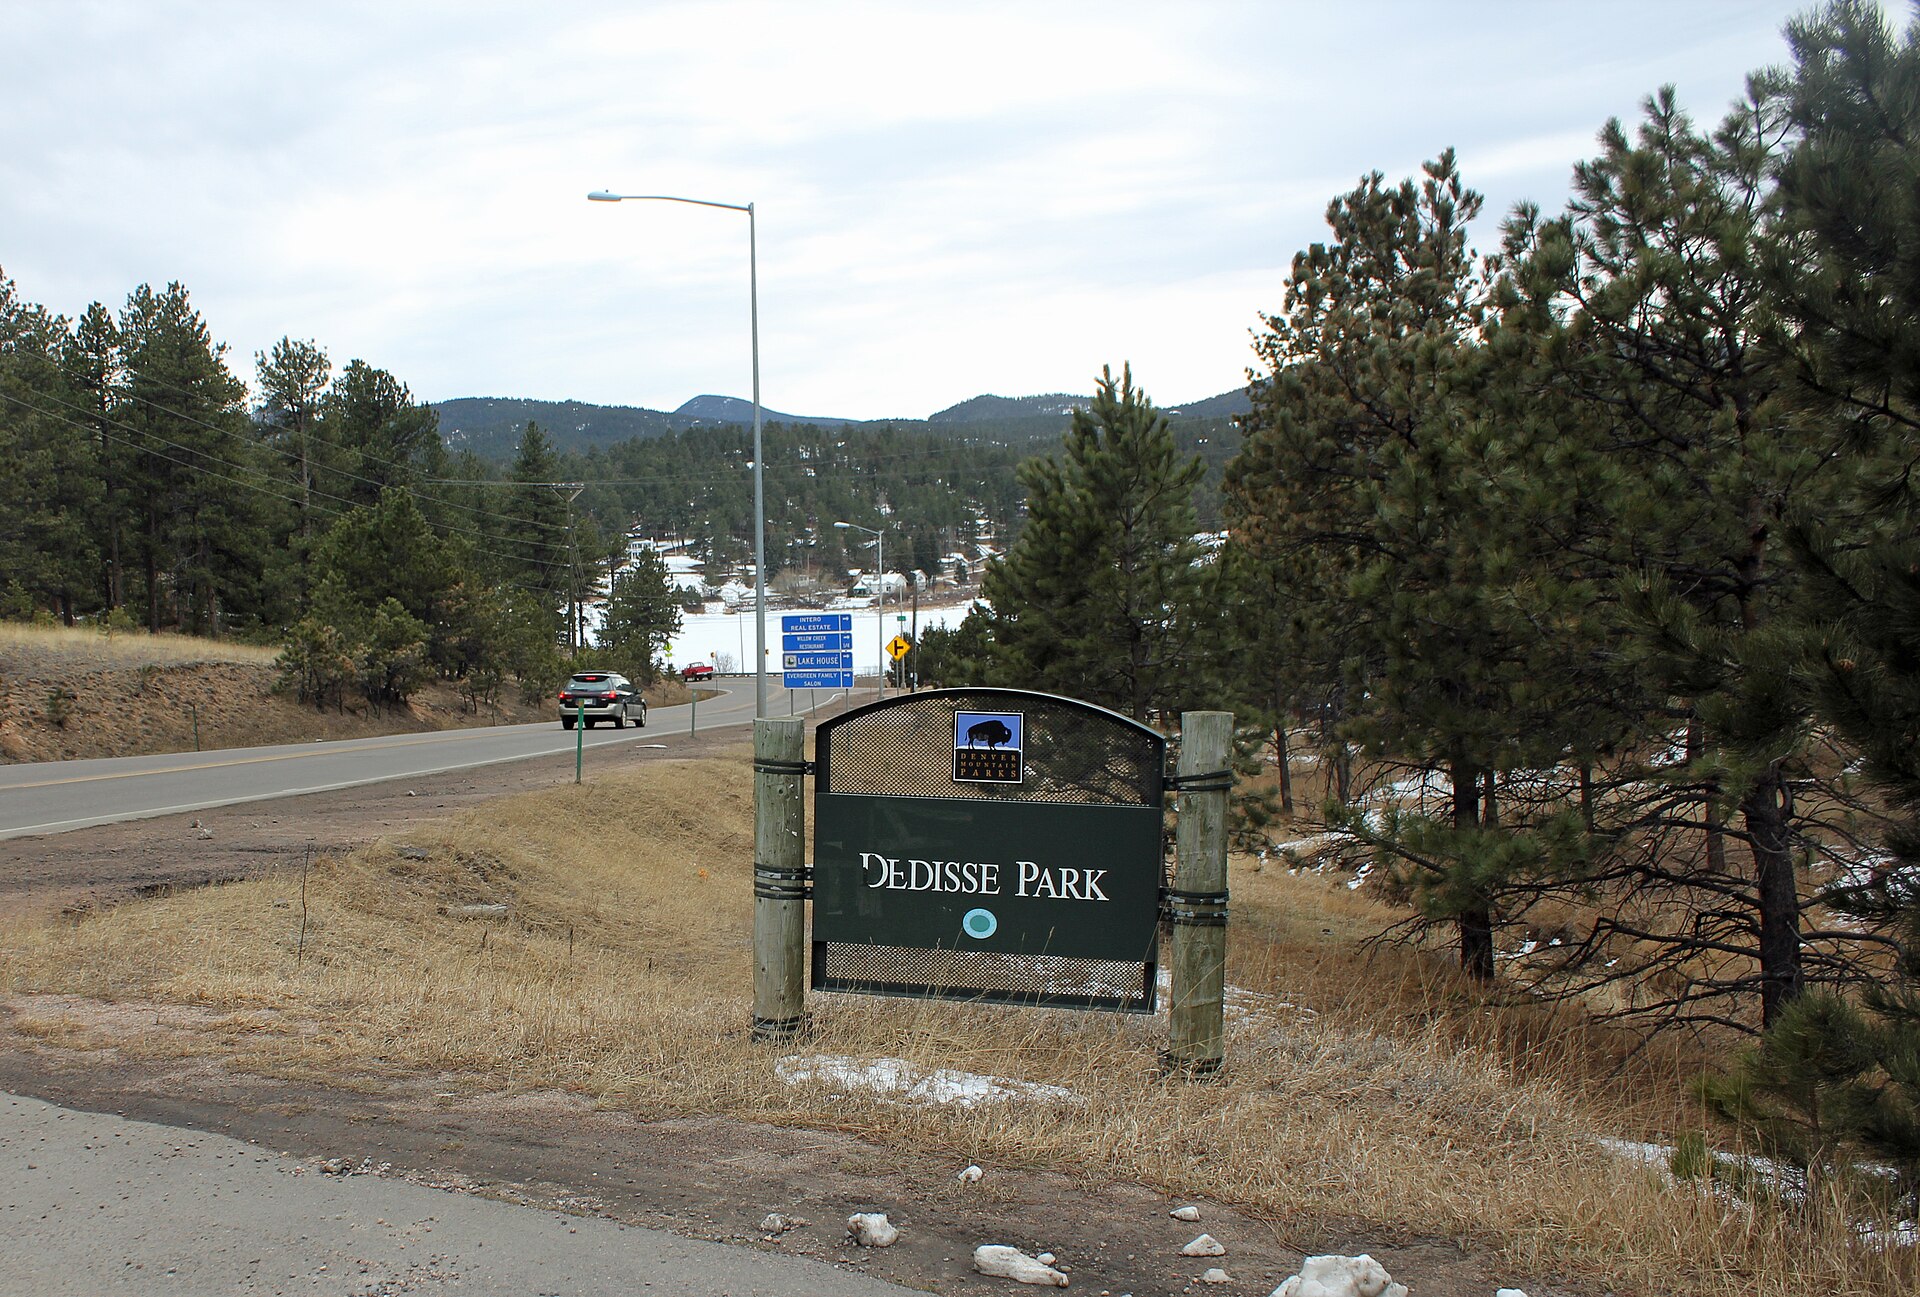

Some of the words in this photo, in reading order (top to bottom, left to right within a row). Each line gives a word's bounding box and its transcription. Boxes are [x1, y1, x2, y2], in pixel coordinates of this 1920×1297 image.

[797, 657, 814, 665] LAKE
[816, 656, 838, 665] HOUSE
[960, 752, 1016, 761] DENVER
[960, 768, 1016, 778] PARKS
[859, 852, 1001, 895] DEDISSE
[1015, 861, 1110, 901] PARK
